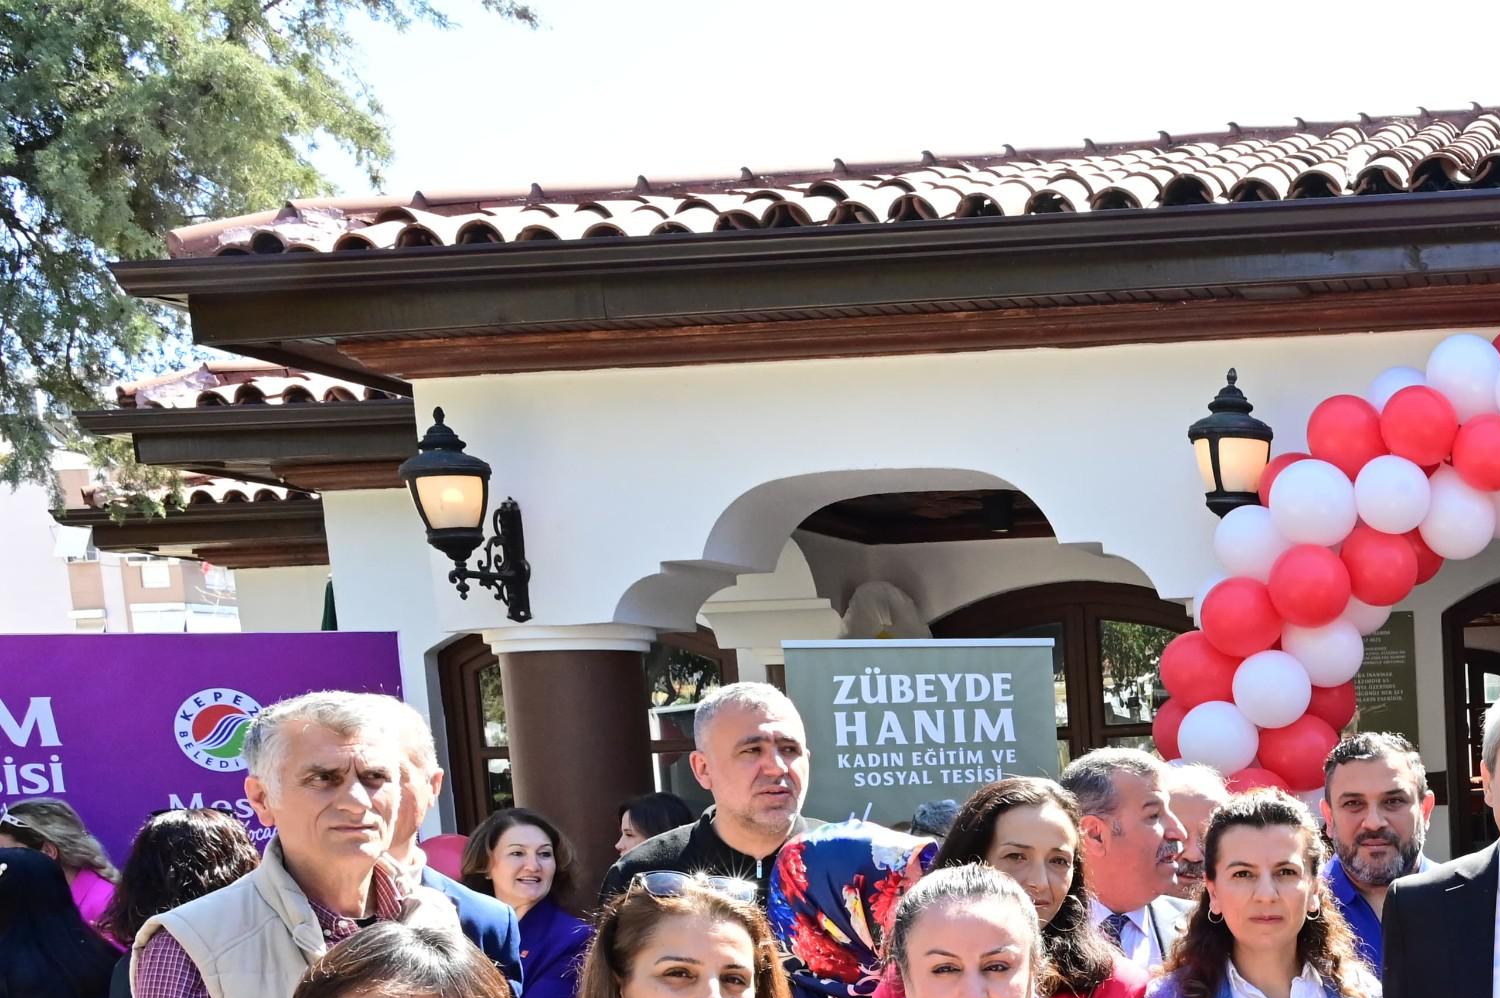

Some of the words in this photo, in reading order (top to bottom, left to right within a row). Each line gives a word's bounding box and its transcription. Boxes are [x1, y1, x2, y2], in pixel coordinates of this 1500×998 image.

[833, 667, 1015, 706] ZÜBEYDE
[180, 691, 261, 722] KEPEZ
[834, 708, 1017, 747] HANIM
[838, 750, 904, 769] KADIN
[912, 747, 985, 766] EĞİTİM
[992, 749, 1017, 764] VE
[854, 770, 933, 788] SOSYAL
[941, 764, 1003, 784] TESİSİ
